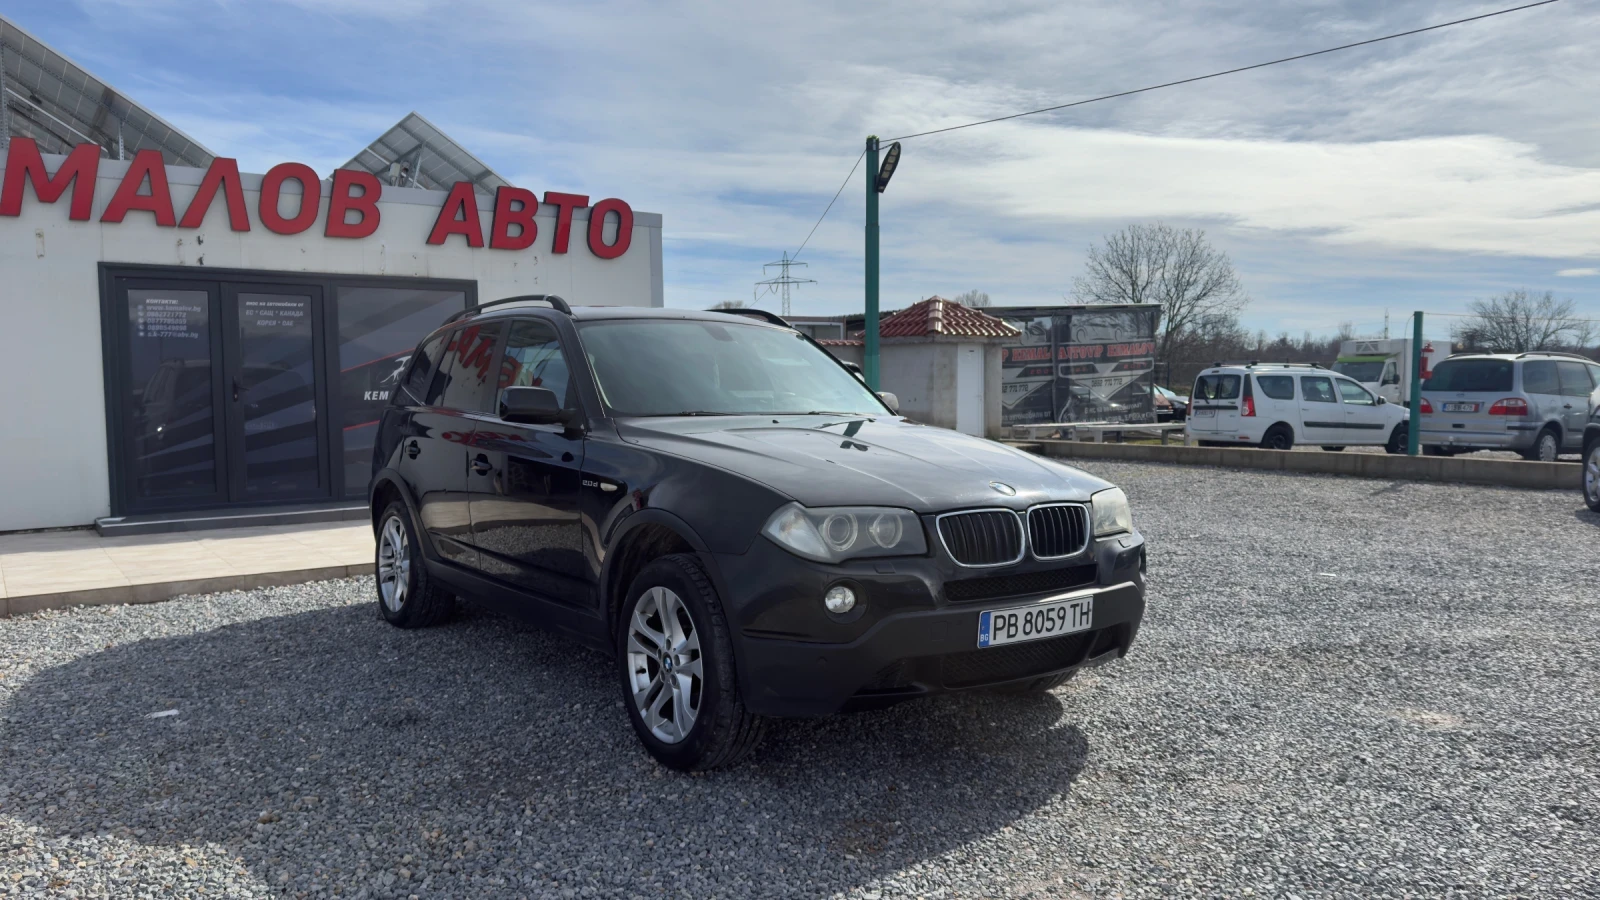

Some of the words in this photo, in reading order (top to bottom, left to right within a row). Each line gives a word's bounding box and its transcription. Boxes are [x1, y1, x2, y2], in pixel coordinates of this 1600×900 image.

[426, 181, 634, 260] АВТО
[980, 633, 989, 642] BG
[993, 613, 1019, 641] PB
[1022, 606, 1067, 636] 8059
[1069, 601, 1091, 628] TH
